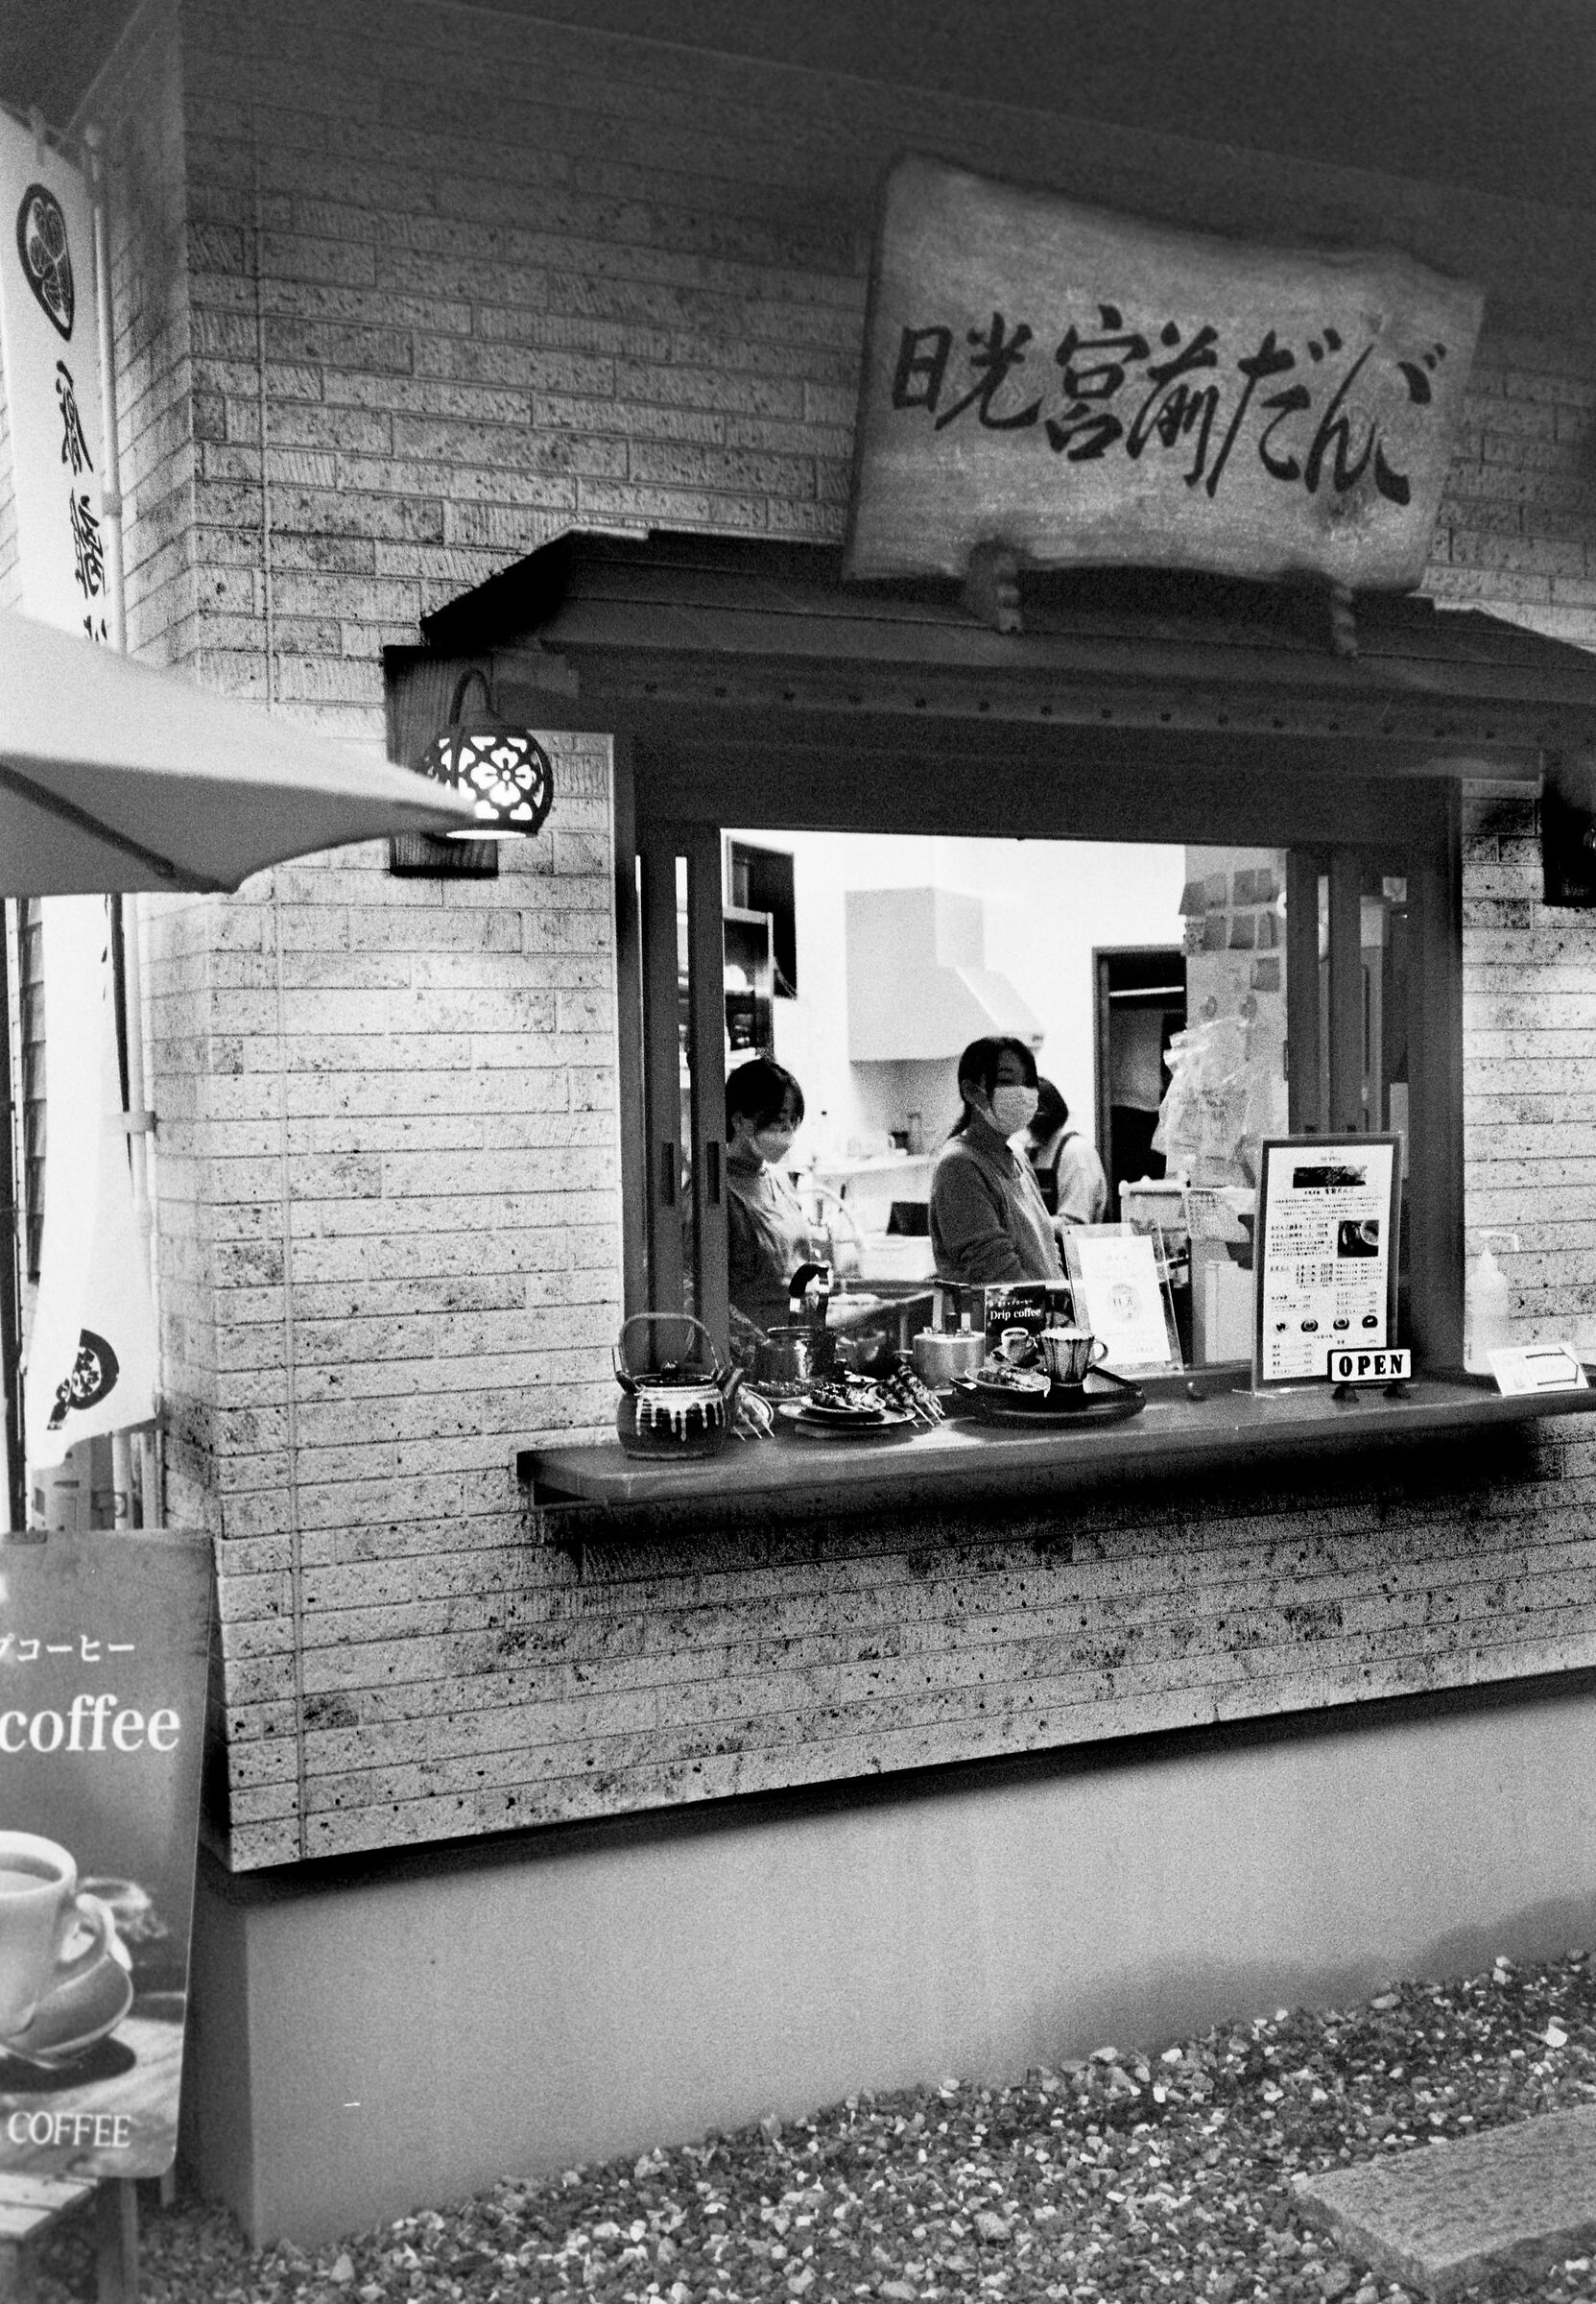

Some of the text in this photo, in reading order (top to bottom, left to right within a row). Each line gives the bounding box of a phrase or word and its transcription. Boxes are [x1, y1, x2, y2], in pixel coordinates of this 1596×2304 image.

[892, 303, 1447, 506] 日光宮前だんご
[989, 1307, 1041, 1322] Drip coffee
[1339, 1354, 1403, 1378] OPEN
[0, 1693, 181, 1753] coffee
[8, 2110, 132, 2148] COFFEE
